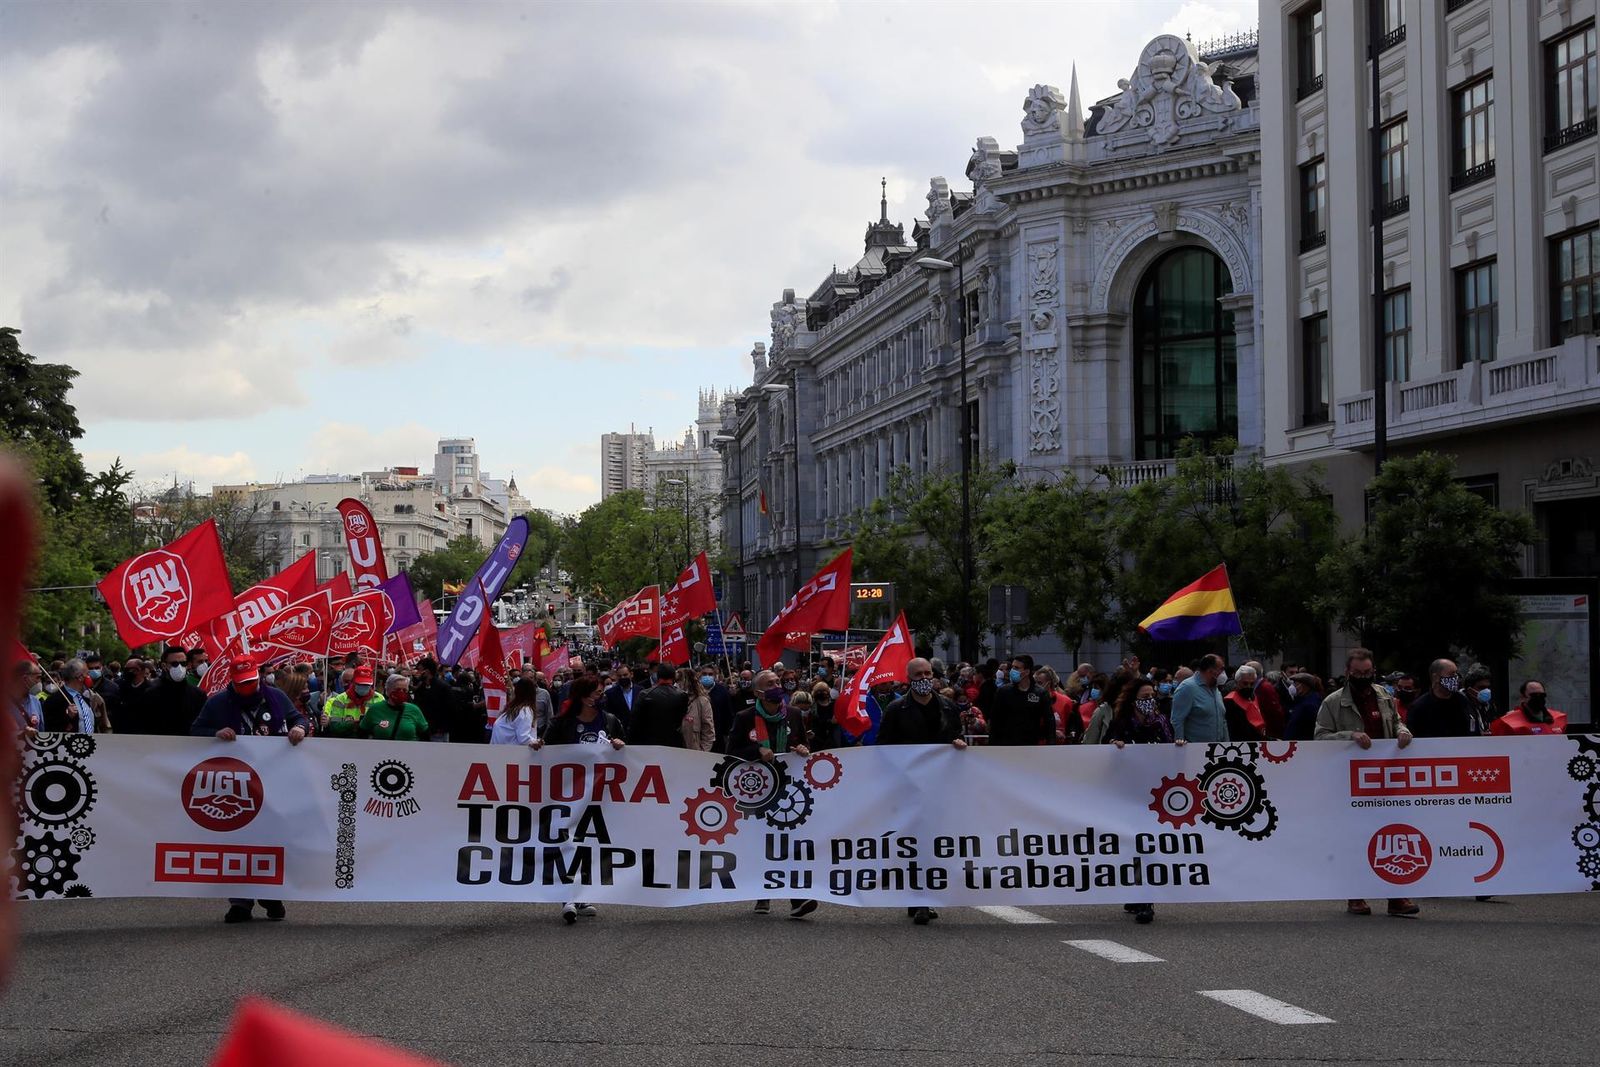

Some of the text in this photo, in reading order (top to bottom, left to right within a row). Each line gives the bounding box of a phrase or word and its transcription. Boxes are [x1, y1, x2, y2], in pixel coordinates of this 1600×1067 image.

[857, 588, 883, 599] 12:20
[334, 640, 361, 650] Madrid
[193, 770, 251, 798] UGT
[458, 763, 670, 804] AHORA
[1358, 765, 1459, 789] CCOO
[364, 797, 421, 817] MAYO 2021
[1351, 795, 1513, 808] comisiones obreras de Madrid
[457, 804, 611, 845] TOCA
[765, 827, 1205, 865] Un país en deuda con
[1376, 834, 1423, 858] UGT
[1439, 845, 1485, 857] Madrid
[164, 849, 278, 878] CCOO
[456, 846, 737, 890] CUMPLIR
[763, 856, 1211, 896] su gente trabajadora
